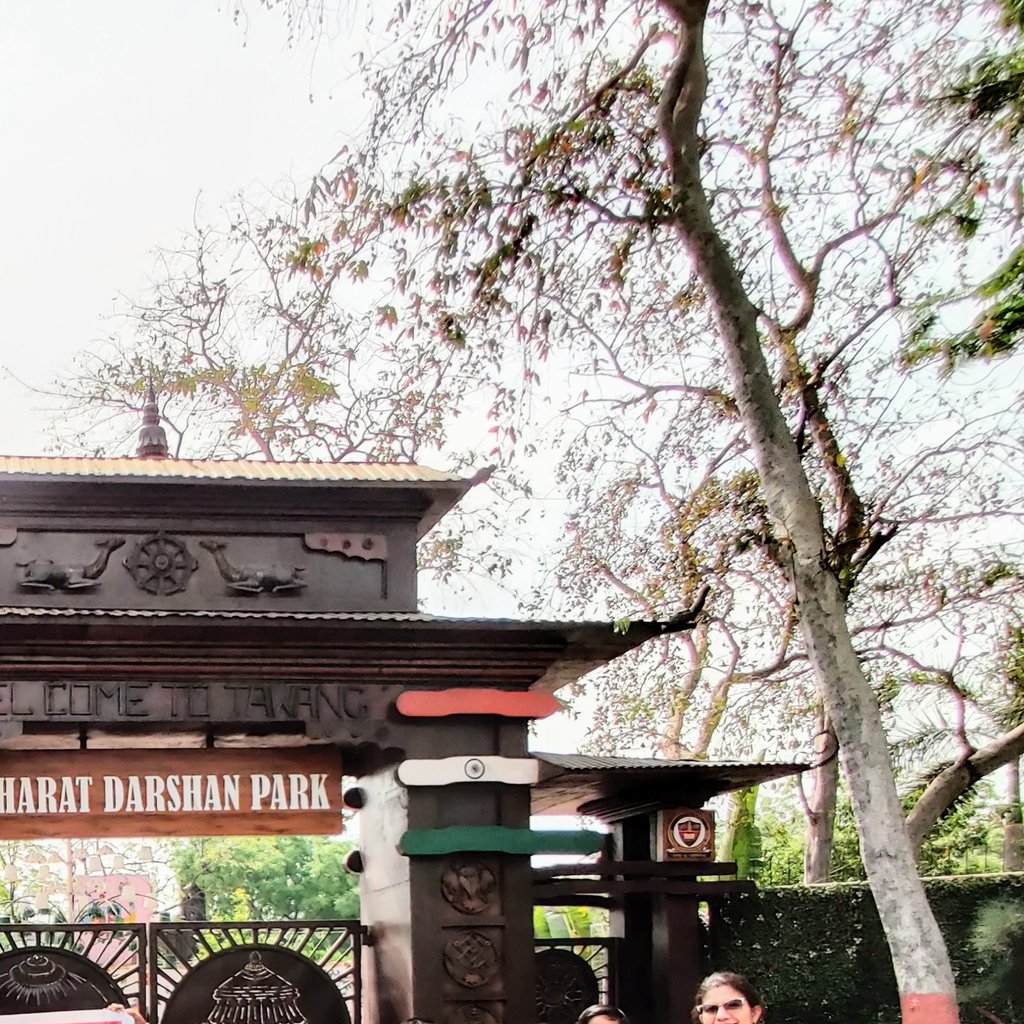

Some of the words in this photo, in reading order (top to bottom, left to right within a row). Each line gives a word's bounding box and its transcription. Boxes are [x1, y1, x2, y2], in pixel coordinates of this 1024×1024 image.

[162, 683, 210, 718] TO
[102, 774, 240, 813] DARSHAN
[250, 773, 330, 810] PARK
